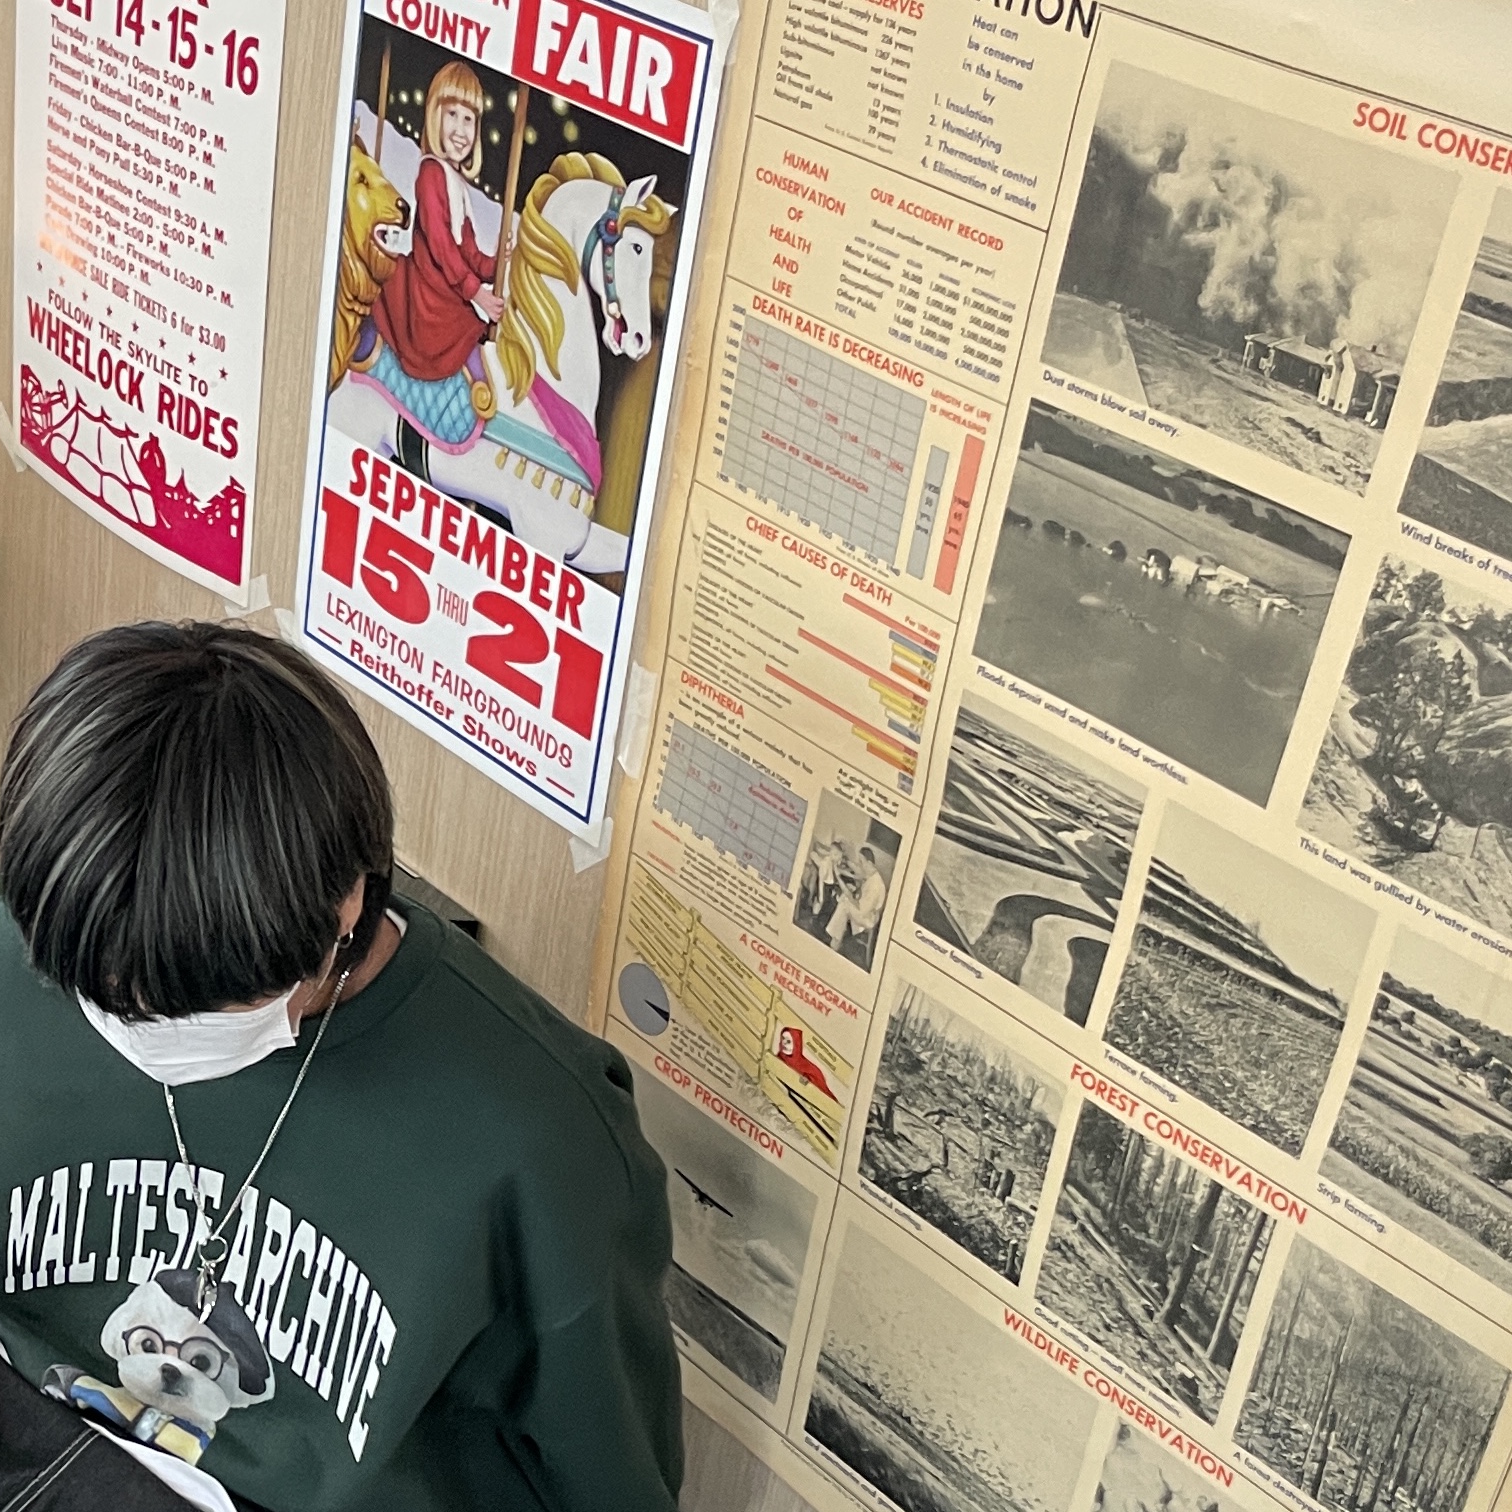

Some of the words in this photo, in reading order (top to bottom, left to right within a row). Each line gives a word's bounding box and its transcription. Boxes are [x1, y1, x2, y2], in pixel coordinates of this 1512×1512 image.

[51, 13, 88, 46] Thursday
[96, 37, 129, 67] Midway
[132, 55, 160, 81] Opens
[163, 70, 185, 91] 5:00
[187, 81, 198, 98] P.
[201, 87, 214, 105] M.
[386, 0, 491, 59] COUNTY
[532, 0, 673, 126] FAIR
[967, 37, 981, 51] be
[984, 44, 1035, 71] conserved
[972, 15, 997, 36] Heat
[1000, 28, 1018, 42] can
[49, 53, 89, 85] Firemen's
[135, 98, 171, 127] Contest
[174, 117, 197, 139] 7:00
[200, 129, 211, 145] P.
[214, 134, 227, 152] M.
[52, 34, 68, 53] Live
[70, 43, 95, 68] Music
[98, 58, 118, 79] 7:00
[128, 74, 154, 97] 11:00
[156, 90, 167, 104] P.
[170, 94, 181, 111] M.
[962, 58, 972, 72] in
[976, 64, 991, 79] the
[995, 69, 1023, 91] home
[982, 88, 995, 106] by
[48, 96, 72, 121] Friday
[80, 115, 113, 143] Chicken
[116, 133, 162, 169] Bar-B-Que
[164, 159, 187, 181] 5:00
[189, 171, 201, 187] P.
[204, 177, 216, 195] M.
[49, 72, 88, 105] Firemen's
[90, 95, 122, 122] Queens
[124, 113, 160, 142] Contest
[162, 132, 184, 154] 8:00
[188, 144, 200, 161] P.
[203, 151, 215, 168] M.
[929, 114, 937, 127] 2.
[941, 118, 1002, 154] Humidifying
[946, 98, 994, 126] Insulation
[1353, 102, 1407, 141] SOIL
[47, 115, 70, 140] Horse
[72, 129, 87, 149] and
[89, 139, 110, 163] Pony
[113, 152, 130, 172] Pull
[132, 163, 153, 184] 5:30
[156, 175, 166, 191] P.
[169, 181, 181, 198] M.
[755, 167, 846, 217] CONSERVATION
[783, 150, 829, 182] HUMAN
[921, 156, 928, 169] 4.
[933, 160, 987, 192] Elimination
[991, 182, 1002, 197] of
[1005, 191, 1037, 212] smoke
[938, 140, 999, 174] Thermostatic
[1002, 165, 1037, 188] control
[89, 163, 133, 199] Horseshoe
[136, 190, 172, 219] Contest
[174, 209, 197, 230] 9:30
[200, 222, 211, 238] A.
[214, 227, 227, 245] M.
[769, 223, 812, 255] HEALTH
[787, 206, 804, 223] OF
[870, 187, 895, 207] OUR
[897, 199, 954, 232] ACCIDENT
[957, 222, 1004, 252] RECORD
[771, 277, 793, 299] LIFE
[772, 253, 799, 275] AND
[48, 288, 93, 332] FOLLOW
[99, 322, 122, 351] THE
[128, 340, 182, 385] SKYLITE
[188, 374, 208, 398] TO
[90, 264, 109, 290] SALE
[133, 289, 167, 324] TICKETS
[171, 311, 177, 329] 6
[181, 316, 194, 338] for
[198, 325, 226, 352] $3.00
[752, 294, 792, 327] DEATH
[794, 315, 827, 343] RATE
[828, 333, 839, 349] IS
[842, 339, 925, 388] DECREASING
[27, 295, 144, 413] WHEELOCK
[157, 382, 238, 459] RIDES
[1042, 369, 1065, 389] Dust
[1067, 379, 1098, 403] storms
[1100, 393, 1126, 413] blow
[1129, 406, 1146, 422] soil
[349, 447, 585, 633] SEPTEMBER
[746, 516, 779, 543] CHIEF
[781, 535, 828, 570] CAUSES
[830, 562, 848, 580] OF
[850, 572, 893, 607] DEATH
[1401, 521, 1433, 545] Wind
[1435, 536, 1474, 564] breaks
[1477, 559, 1492, 571] of
[321, 486, 435, 625] 15
[436, 582, 469, 627] THRU
[465, 590, 604, 742] 21
[326, 592, 424, 674] LEXINGTON
[432, 660, 573, 769] FAIRGROUNDS
[350, 639, 455, 721] Reithoffer
[463, 715, 537, 778] Shows
[680, 670, 745, 719] DIPHTHERIA
[1299, 837, 1319, 856] This
[1323, 848, 1347, 870] land
[1350, 865, 1371, 883] was
[1374, 880, 1414, 905] gullied
[1415, 898, 1431, 916] by
[1434, 910, 1469, 933] water
[739, 933, 748, 946] A
[750, 939, 803, 981] COMPLETE
[804, 974, 859, 1020] PROGRAM
[758, 961, 768, 974] IS
[773, 970, 833, 1019] NECESSARY
[654, 1055, 692, 1090] CROP
[694, 1083, 785, 1160] PROTECTION
[1070, 1062, 1140, 1118] FOREST
[1143, 1111, 1308, 1225] CONSERVATION
[1317, 1182, 1341, 1205] Strip
[4, 1158, 226, 1294] MALTESE
[220, 1185, 397, 1463] ARCHIVE
[1003, 1307, 1079, 1375] WILDLIFE
[1083, 1369, 1234, 1488] CONSERVATION
[1233, 1451, 1241, 1462] A
